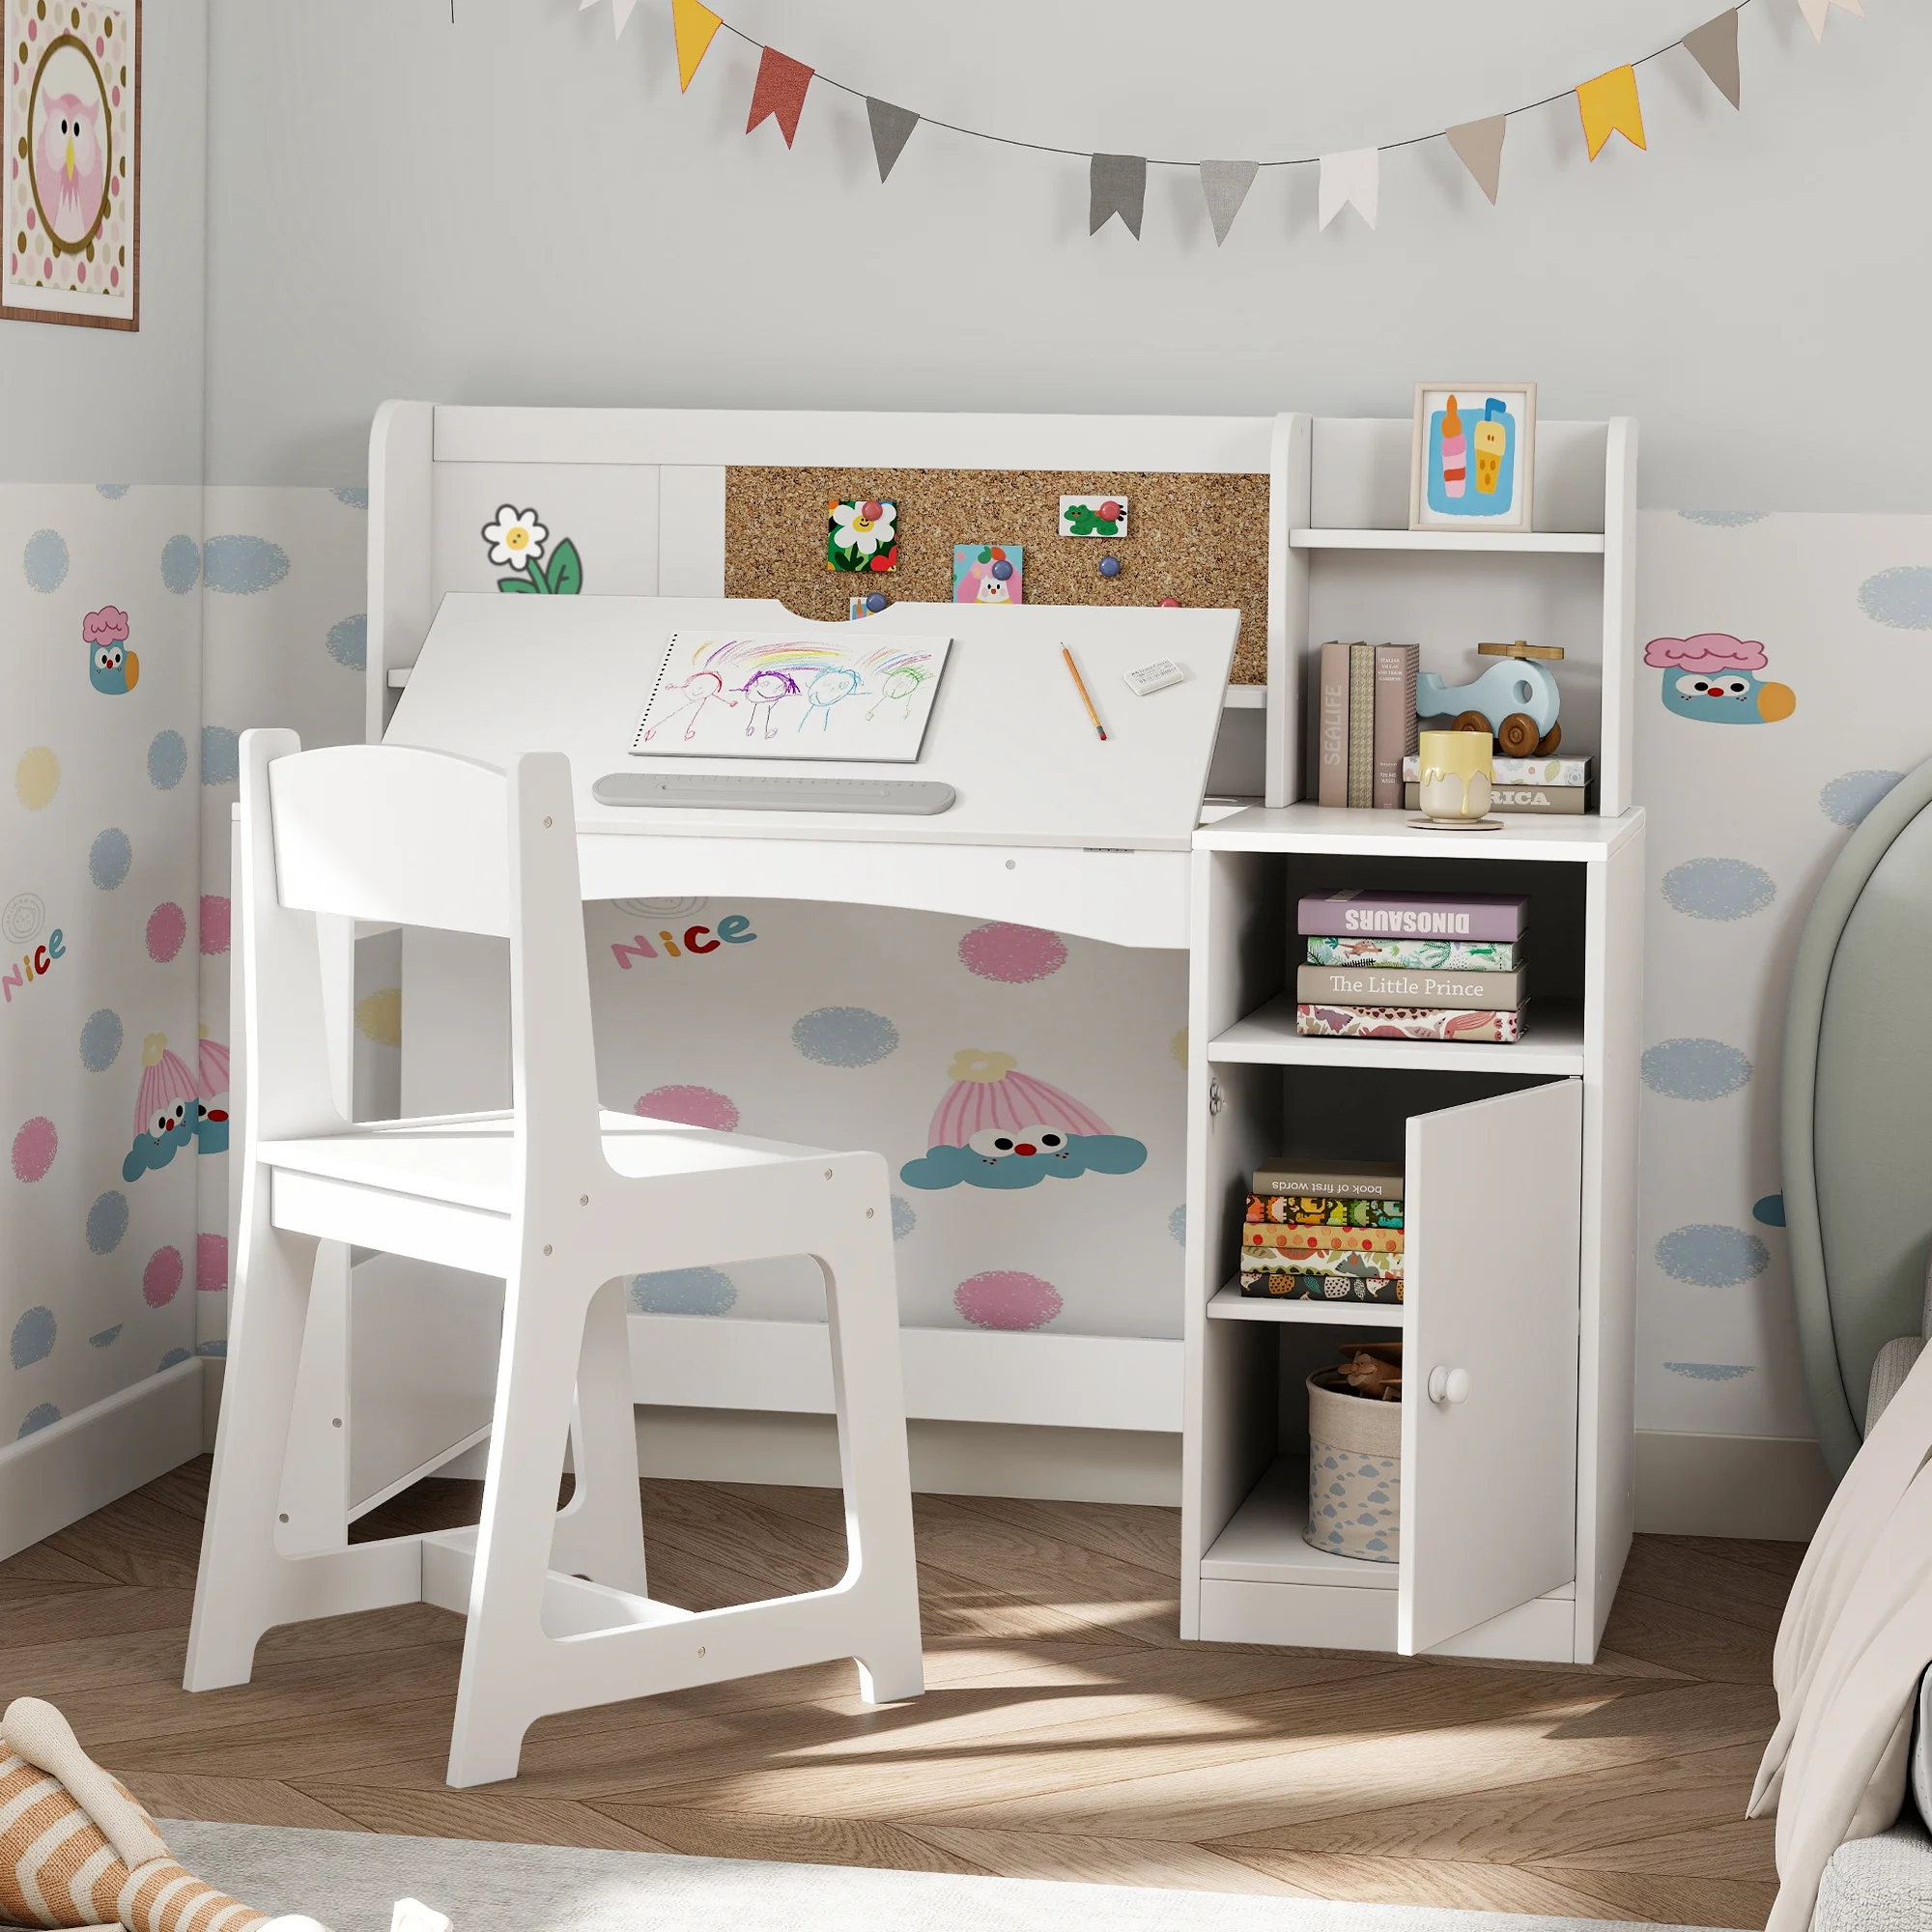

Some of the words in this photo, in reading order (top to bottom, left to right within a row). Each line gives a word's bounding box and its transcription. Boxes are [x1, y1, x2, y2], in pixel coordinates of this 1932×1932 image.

[1324, 685, 1341, 764] SEALIFE
[1491, 790, 1550, 805] RICA
[1345, 908, 1470, 934] DINOSAURS
[611, 915, 757, 970] Nice
[2, 928, 67, 1003] Nice
[1329, 976, 1363, 993] The
[1368, 977, 1419, 995] Little
[1424, 979, 1484, 997] Prince
[1272, 1180, 1308, 1191] words
[1312, 1182, 1334, 1194] first
[1336, 1184, 1350, 1194] of
[1352, 1184, 1382, 1195] book
